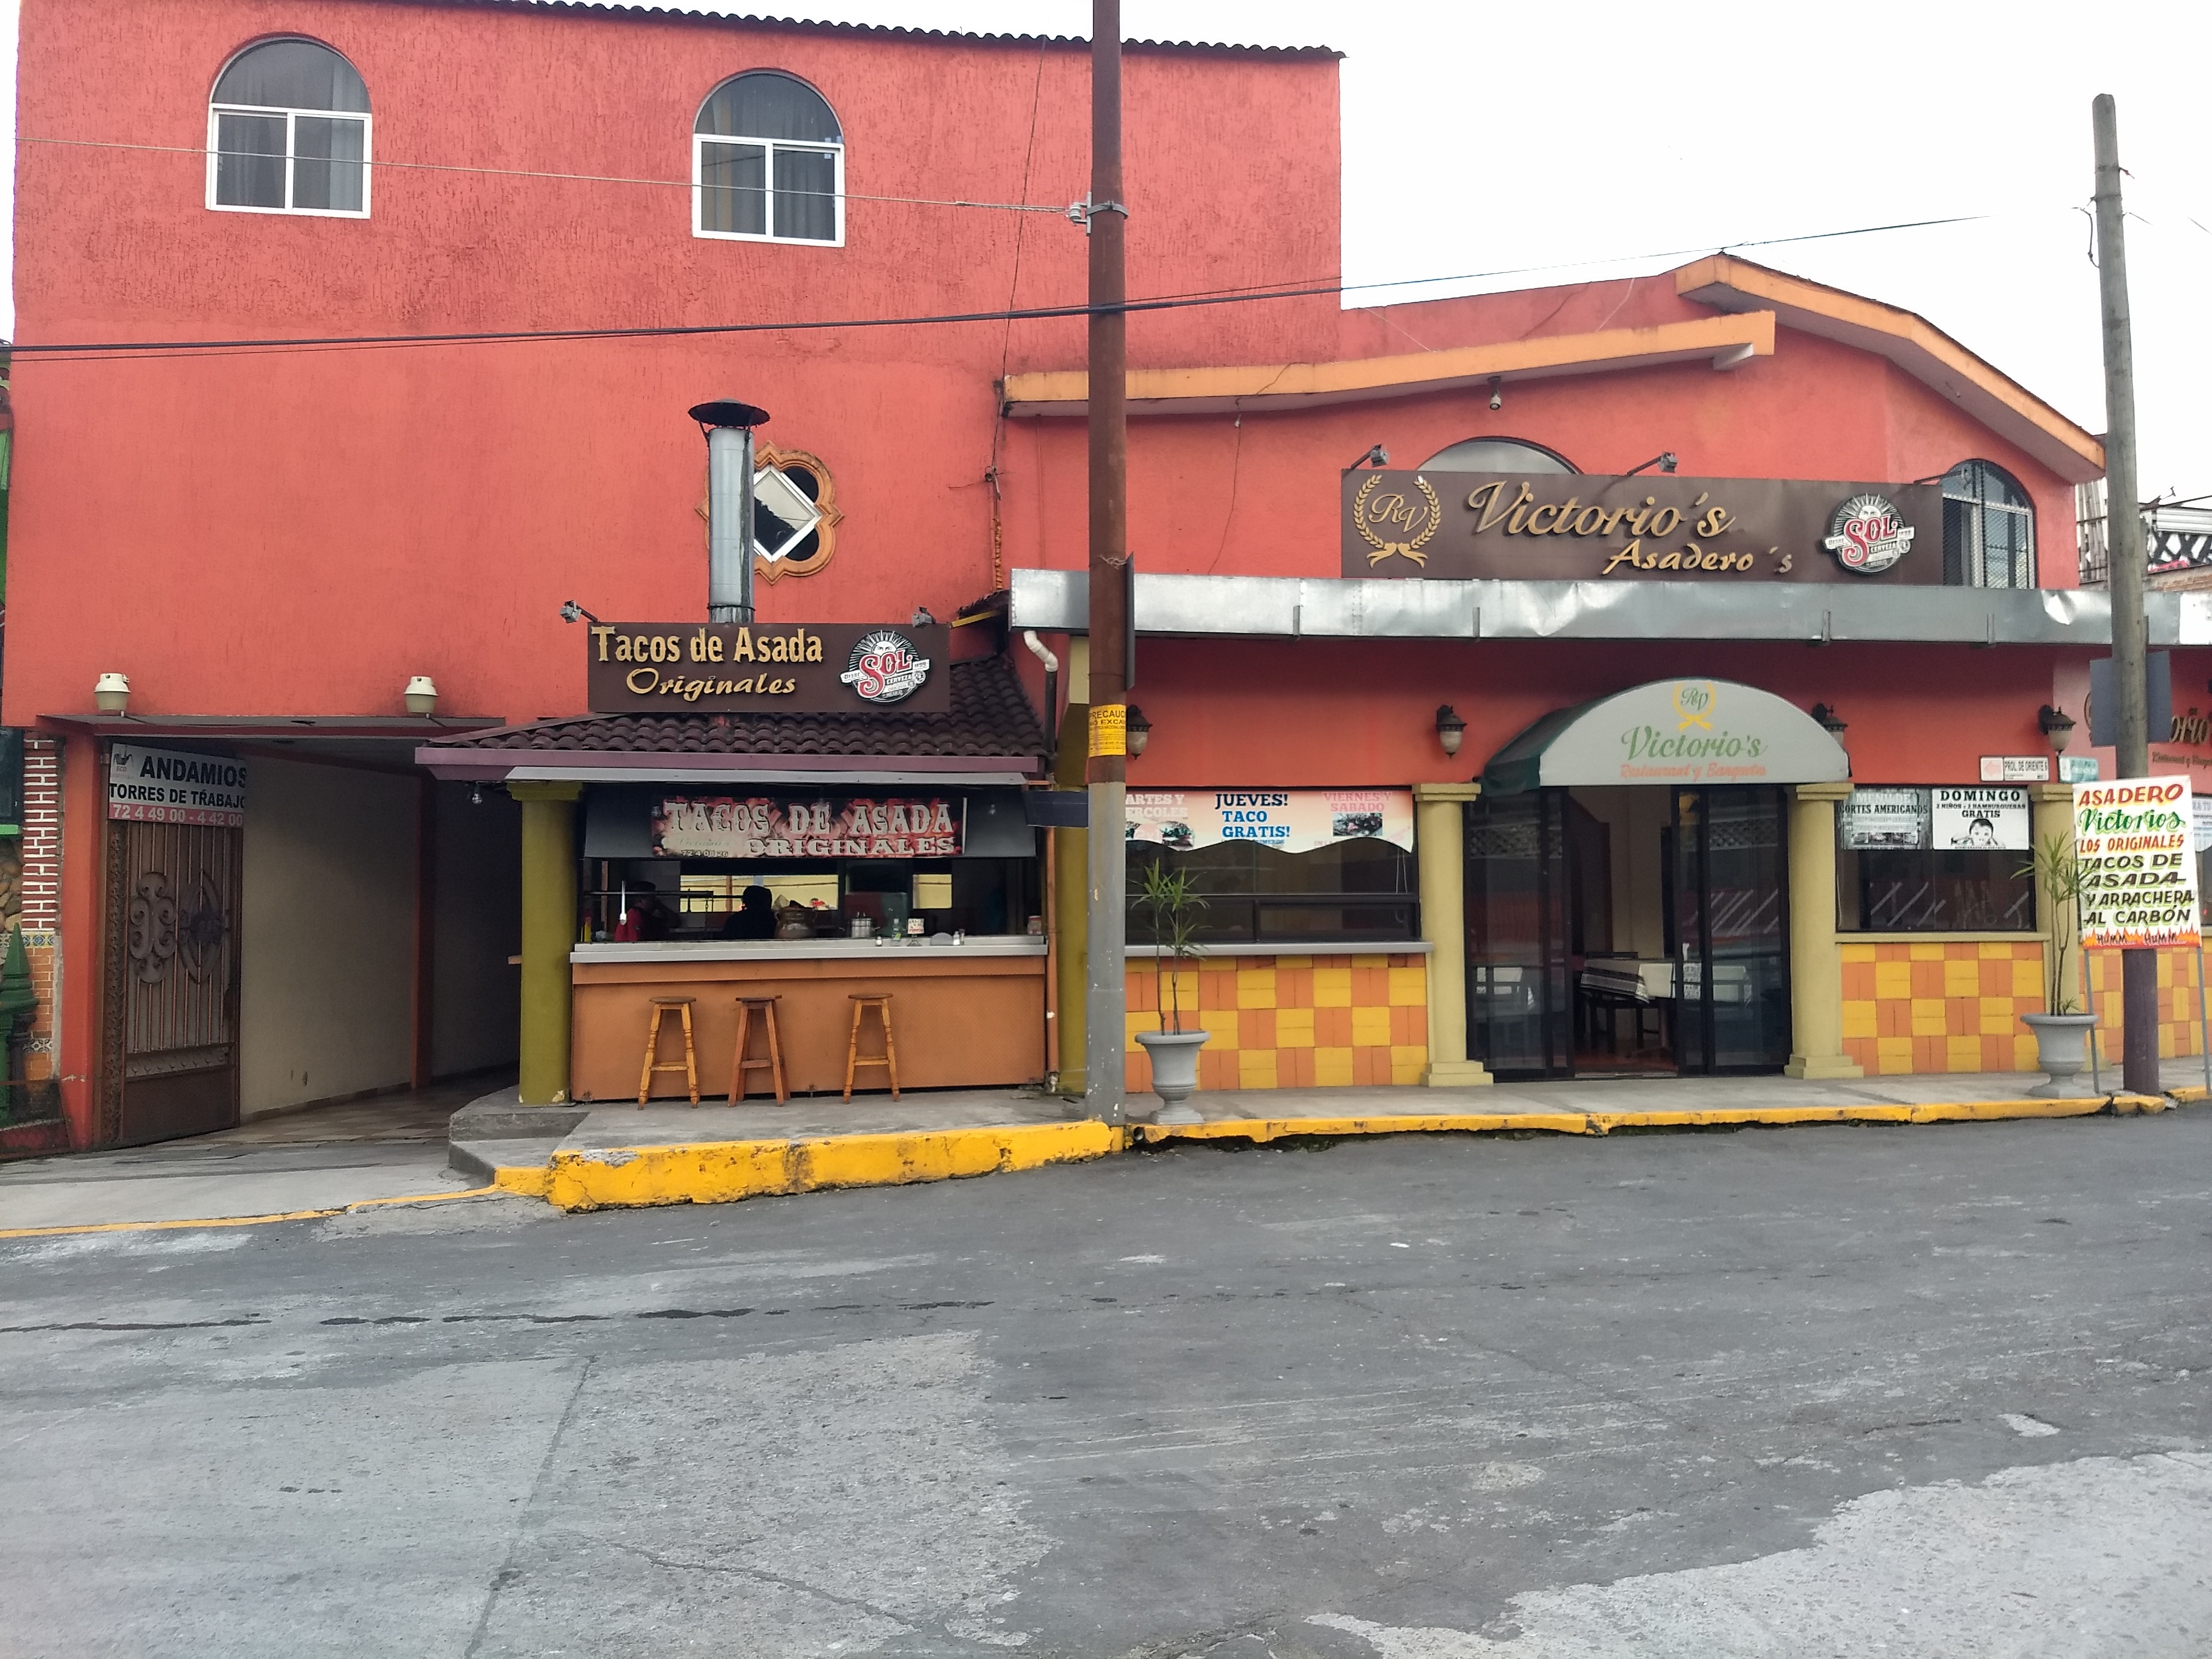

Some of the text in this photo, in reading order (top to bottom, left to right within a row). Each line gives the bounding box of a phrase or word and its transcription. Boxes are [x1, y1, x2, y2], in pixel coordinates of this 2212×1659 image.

[1468, 481, 1736, 538] Victorio's
[1842, 515, 1898, 567] SOL
[1870, 541, 1897, 553] CERVEZA
[591, 627, 823, 663] Tacos de Asada
[857, 649, 913, 698] SOL
[886, 674, 912, 685] CERVEZA
[627, 668, 795, 702] Originales
[1621, 726, 1768, 761] Victorio's
[139, 755, 246, 788] ANDAMIOS
[110, 783, 165, 802] TORRES
[170, 788, 187, 804] DE
[1126, 794, 1185, 805] ARTES Y
[1215, 794, 1289, 810] JUEVES!
[1322, 792, 1392, 802] VIERNES Y
[1940, 791, 2021, 802] DOMINGO
[2078, 783, 2184, 806] ASADERO
[112, 804, 131, 819] 72
[134, 805, 144, 820] 4
[148, 805, 165, 821] 49
[169, 809, 185, 822] 00
[197, 811, 206, 823] 4
[1125, 806, 1188, 817] ERCOLES
[1222, 810, 1268, 822] TACO
[1330, 803, 1385, 812] SABADO
[1840, 804, 1928, 814] CORTES AMERICANOS
[1961, 810, 2001, 818] GRATIS
[664, 802, 954, 836] TACOS DE ASADA
[2079, 808, 2187, 833] Victorios
[1222, 826, 1290, 838] GRATIS!
[746, 837, 955, 856] ORIGINALES
[2079, 834, 2185, 854] LOS ORIGINALES
[2083, 853, 2183, 871] TACOS DE
[2086, 871, 2187, 888] ASADA
[2098, 889, 2195, 906] ARRACHERA
[2084, 905, 2192, 926] AL CARBÓN
